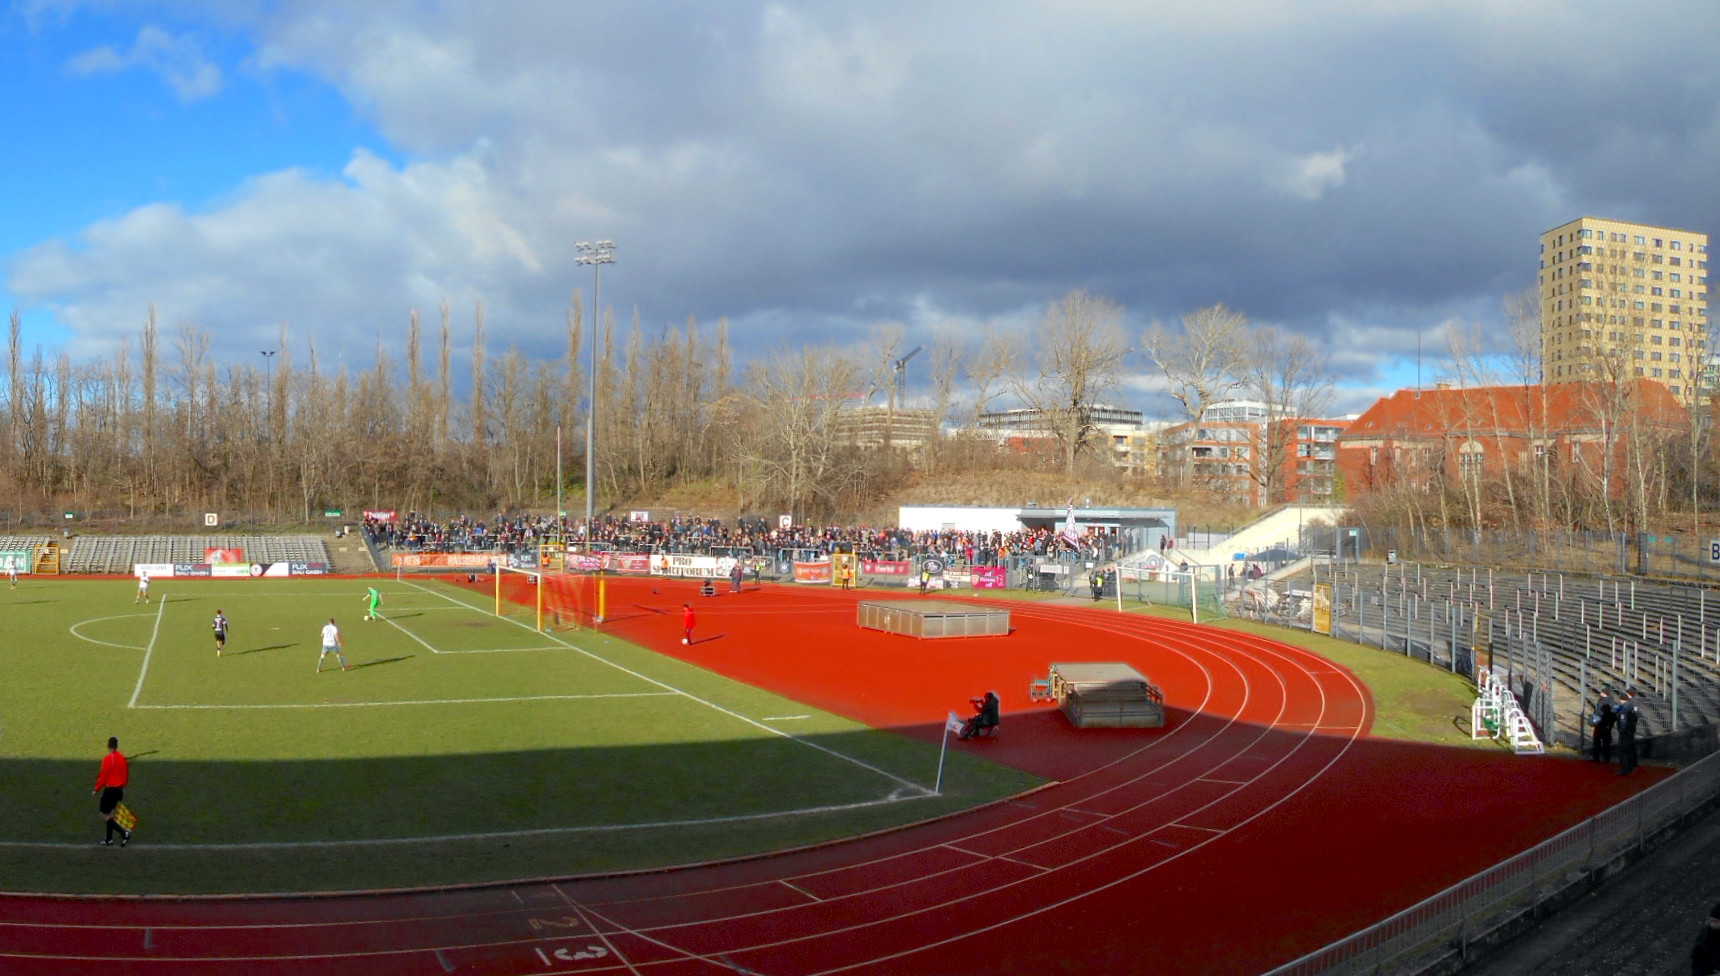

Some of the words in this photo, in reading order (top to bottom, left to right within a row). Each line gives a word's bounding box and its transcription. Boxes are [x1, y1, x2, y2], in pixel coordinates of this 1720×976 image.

[207, 515, 215, 524] D
[782, 517, 790, 527] C
[1712, 543, 1720, 560] B
[673, 557, 692, 566] PRO
[652, 565, 714, 577] SPRTFORUM
[554, 945, 608, 961] 3
